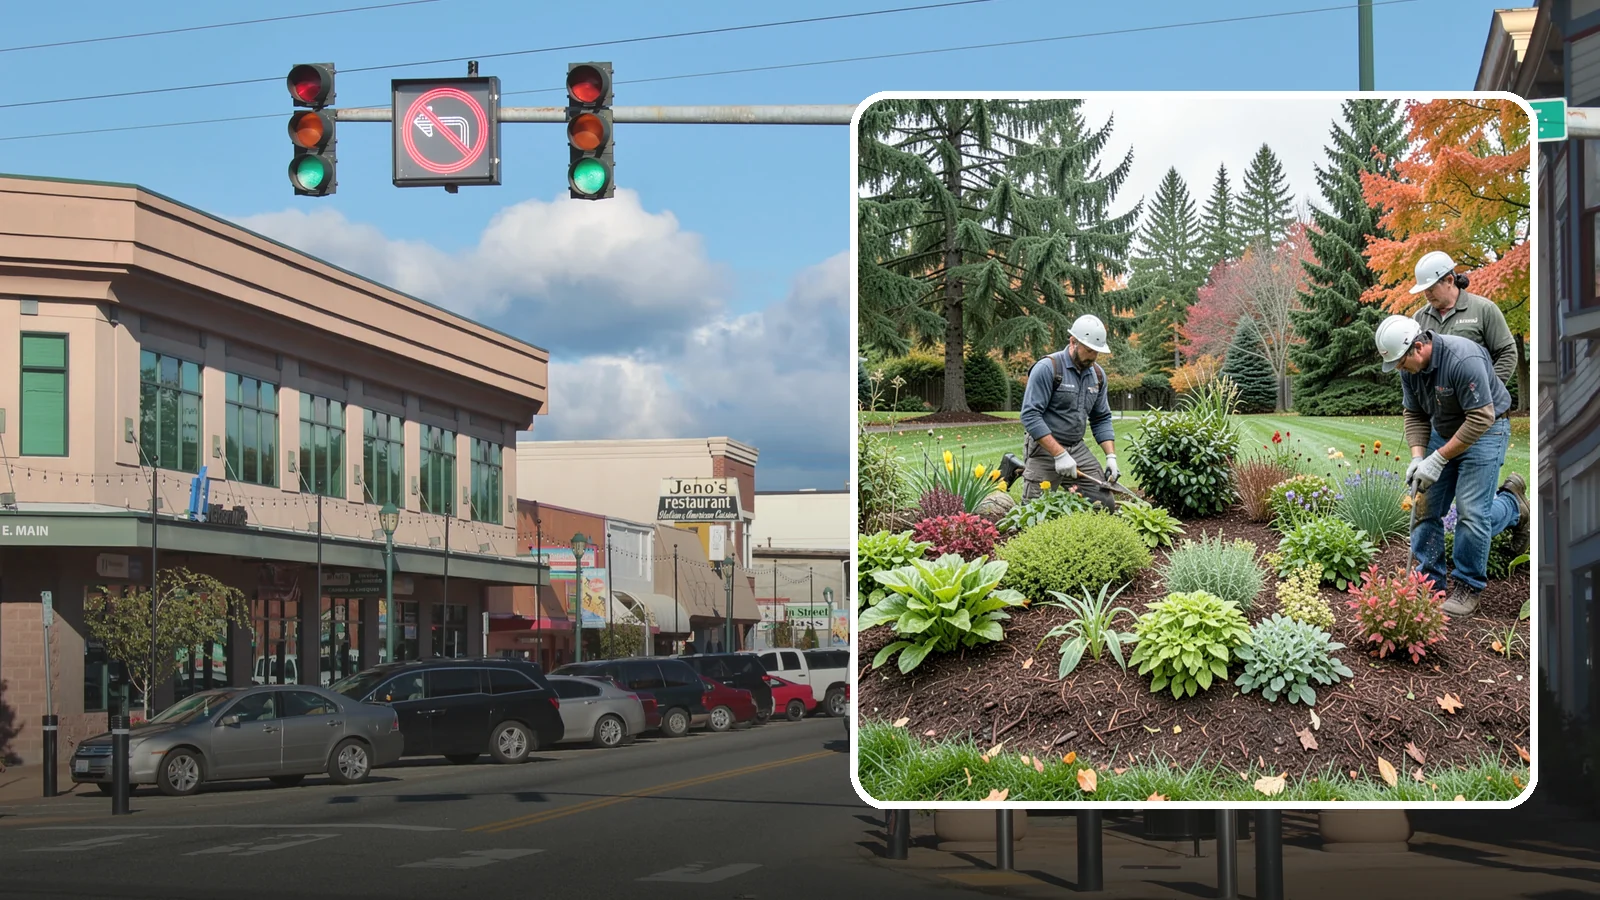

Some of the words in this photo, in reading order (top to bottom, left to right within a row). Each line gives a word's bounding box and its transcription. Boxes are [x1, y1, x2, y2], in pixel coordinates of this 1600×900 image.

[670, 480, 727, 494] Jeno's
[665, 497, 730, 509] restaurant
[658, 510, 681, 519] Italian
[685, 510, 714, 519] American
[715, 510, 738, 519] Cuisine
[2, 525, 13, 536] E.
[15, 525, 49, 537] MAIN
[797, 608, 829, 616] Street
[791, 619, 824, 627] lass
